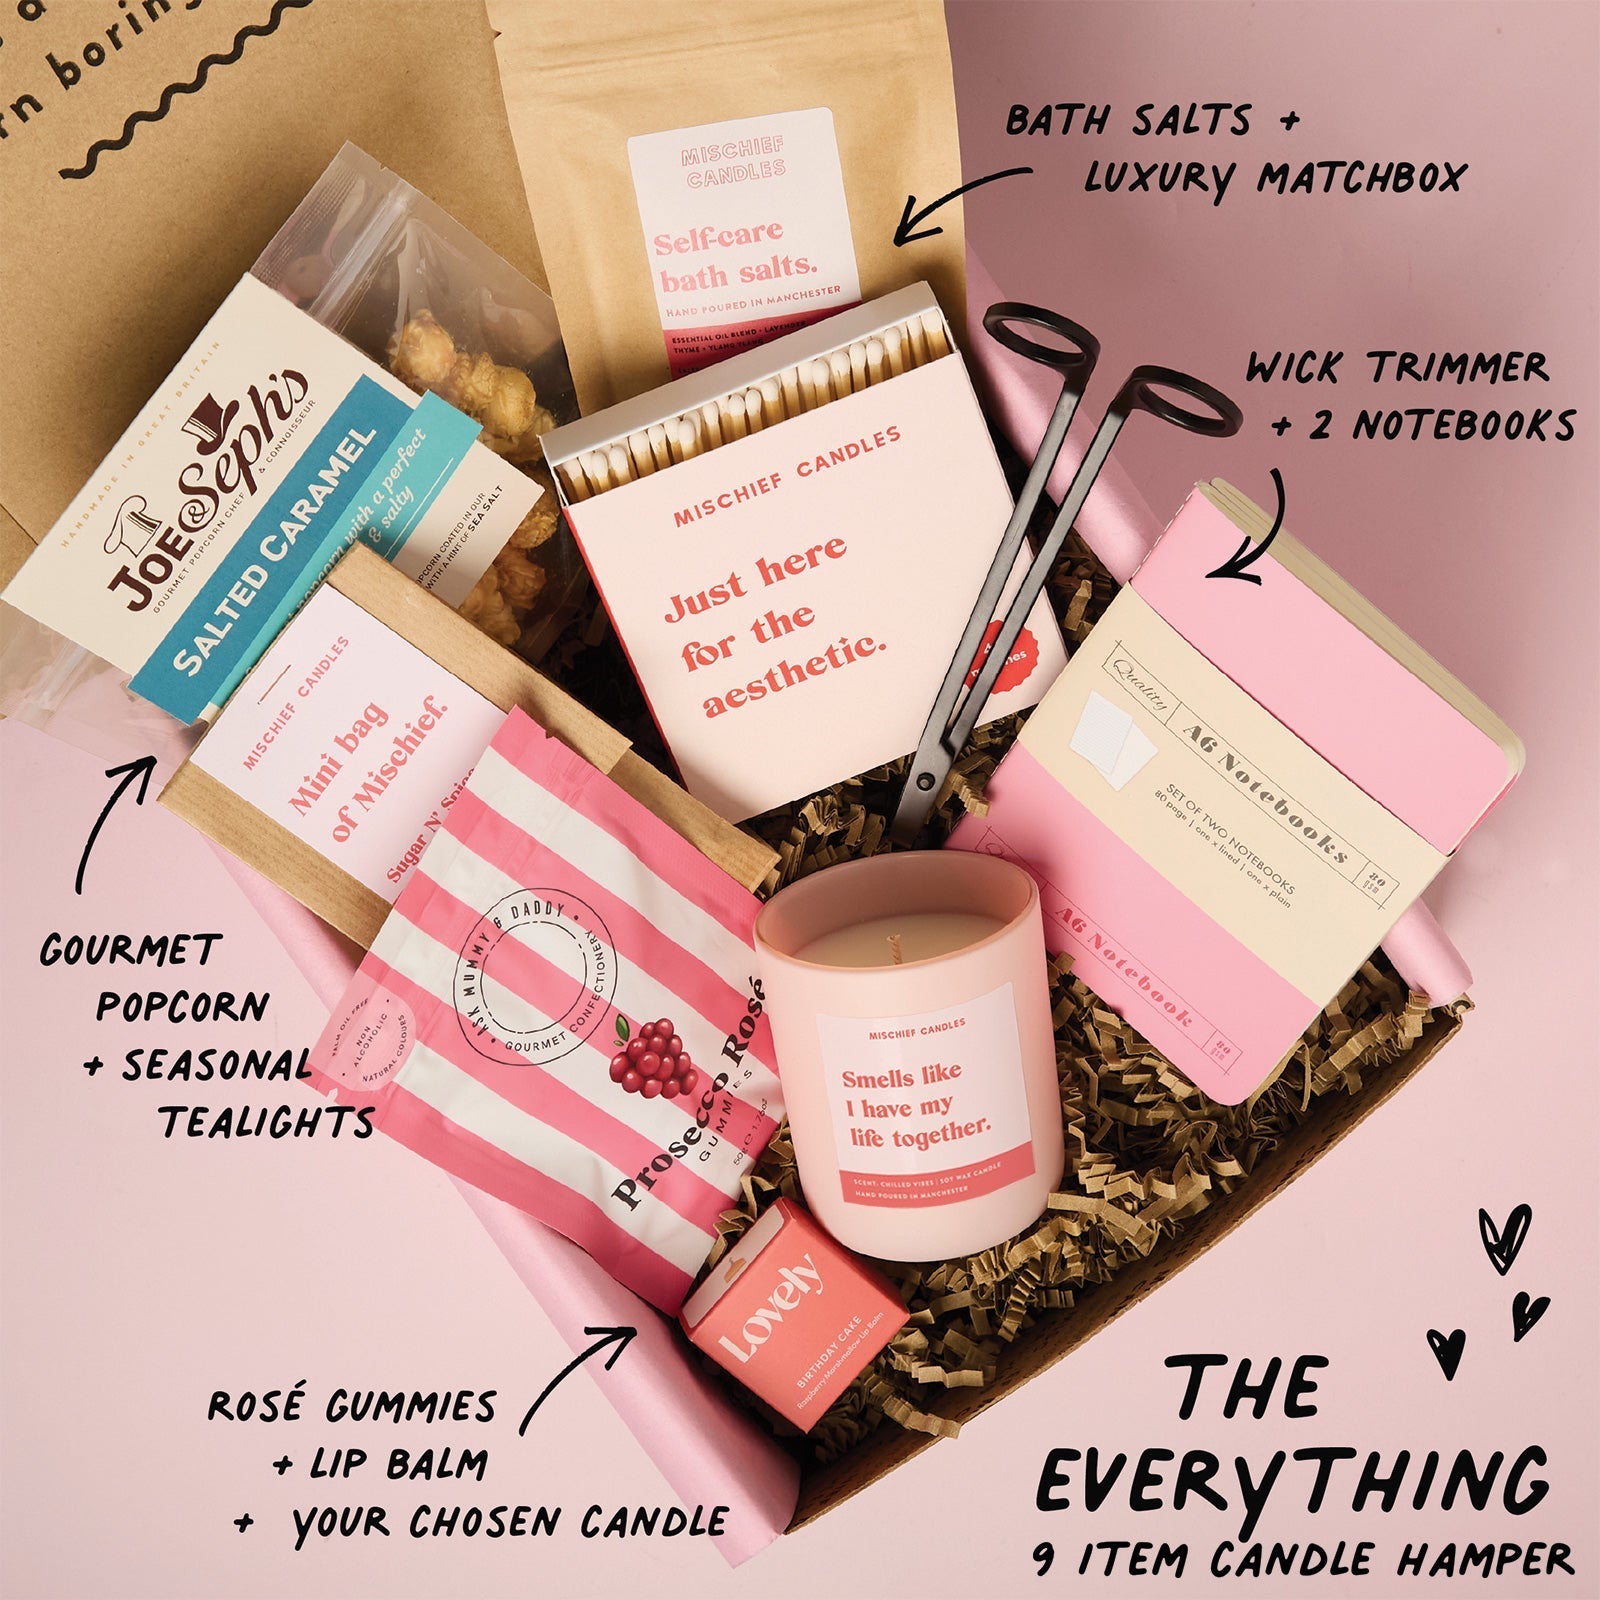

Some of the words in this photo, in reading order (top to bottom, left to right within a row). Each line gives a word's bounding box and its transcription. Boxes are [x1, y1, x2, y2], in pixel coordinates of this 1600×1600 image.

[45, 0, 201, 91] borin
[681, 135, 784, 167] MISCHIEF
[686, 159, 787, 189] CANDLES
[653, 222, 784, 256] Self-care
[660, 264, 728, 294] bath
[739, 255, 818, 285] salts.
[666, 307, 698, 318] HAND
[702, 300, 747, 315] POURED
[751, 297, 763, 308] IN
[766, 285, 841, 305] MANCHESTER
[672, 334, 713, 345] ESSENTIAL
[715, 332, 729, 341] OIL
[731, 329, 757, 339] BLEND
[673, 345, 700, 354] THYME
[61, 475, 119, 548] HANDMADE
[121, 453, 135, 469] IN
[138, 403, 171, 447] GREAT
[175, 340, 220, 398] BRITAIN
[673, 472, 782, 528] MISCHIEF
[796, 425, 902, 477] CANDLES
[153, 567, 190, 614] GOURMET
[189, 520, 226, 566] POPCORN
[224, 492, 246, 520] CHEF
[266, 399, 317, 465] CONNOISSEUR
[345, 503, 374, 545] with
[372, 490, 385, 506] a
[383, 427, 427, 491] perfect
[369, 526, 382, 544] &
[380, 485, 415, 529] salty
[172, 564, 269, 677] SALTED
[259, 427, 377, 562] CARAMEL
[425, 568, 444, 590] WITH
[446, 542, 462, 562] HINT
[460, 531, 470, 543] OF
[467, 512, 485, 532] SEA
[483, 484, 503, 511] SALT
[440, 521, 465, 553] COATED
[462, 511, 472, 522] IN
[470, 492, 486, 511] OUR
[106, 526, 195, 612] JOE
[664, 571, 749, 624] Just
[755, 537, 848, 587] here
[681, 634, 736, 673] for
[750, 605, 816, 645] the
[243, 702, 297, 771] MISCHIEF
[297, 635, 350, 698] CANDLES
[702, 636, 887, 719] aesthetic.
[287, 752, 344, 818] Mini
[333, 702, 389, 755] bag
[331, 805, 359, 843] of
[352, 694, 449, 812] Mischief.
[1113, 659, 1168, 712] Quality
[1182, 724, 1219, 754] A6
[1217, 751, 1349, 865] Notebooks
[386, 834, 427, 884] Sugar
[1154, 790, 1168, 802] 80
[1166, 801, 1187, 820] page
[1195, 826, 1211, 841] one
[1218, 844, 1241, 864] lined
[1246, 870, 1262, 885] one
[1268, 890, 1291, 908] plain
[1166, 783, 1186, 802] SET
[1185, 800, 1203, 815] OF
[1202, 813, 1228, 838] TWO
[1228, 837, 1295, 895] NOTEBOOKS
[511, 900, 565, 920] DADDY
[463, 932, 490, 997] MUMMY
[505, 1031, 568, 1052] GOURMET
[569, 930, 606, 1033] CONFECTIONERY
[1055, 907, 1087, 934] A6
[1087, 932, 1194, 1028] Notebook
[340, 1015, 351, 1031] OIL
[353, 1013, 388, 1068] ALCOHOLIC
[356, 1025, 371, 1047] NON
[362, 1059, 398, 1082] NATURAL
[396, 1014, 408, 1057] COLOURS
[467, 1006, 490, 1037] ASK
[869, 1028, 916, 1041] MISCHIEF
[920, 1017, 966, 1036] CANDLES
[611, 1072, 729, 1212] Prosecco
[721, 975, 766, 1068] Rosé
[842, 1069, 915, 1089] Smells
[921, 1063, 963, 1085] like
[846, 1100, 855, 1117] I
[861, 1099, 913, 1118] have
[920, 1096, 954, 1116] my
[699, 1069, 753, 1163] GUMMIES
[850, 1127, 885, 1148] life
[892, 1117, 992, 1152] together.
[855, 1190, 876, 1199] HAND
[878, 1192, 908, 1200] POURED
[920, 1186, 969, 1199] MANCHESTER
[880, 1181, 912, 1189] CHILLED
[913, 1179, 934, 1188] VIBES
[939, 1176, 954, 1185] SOY
[956, 1172, 972, 1182] WAX
[973, 1162, 1001, 1177] CANDLE
[718, 1253, 824, 1364] Lovely
[797, 1342, 839, 1389] BIRTHDAY
[838, 1315, 862, 1342] CAKE
[797, 1379, 827, 1410] Raspberry
[824, 1338, 861, 1379] Marshmallow
[859, 1328, 870, 1339] Lip
[866, 1312, 884, 1329] Balm
